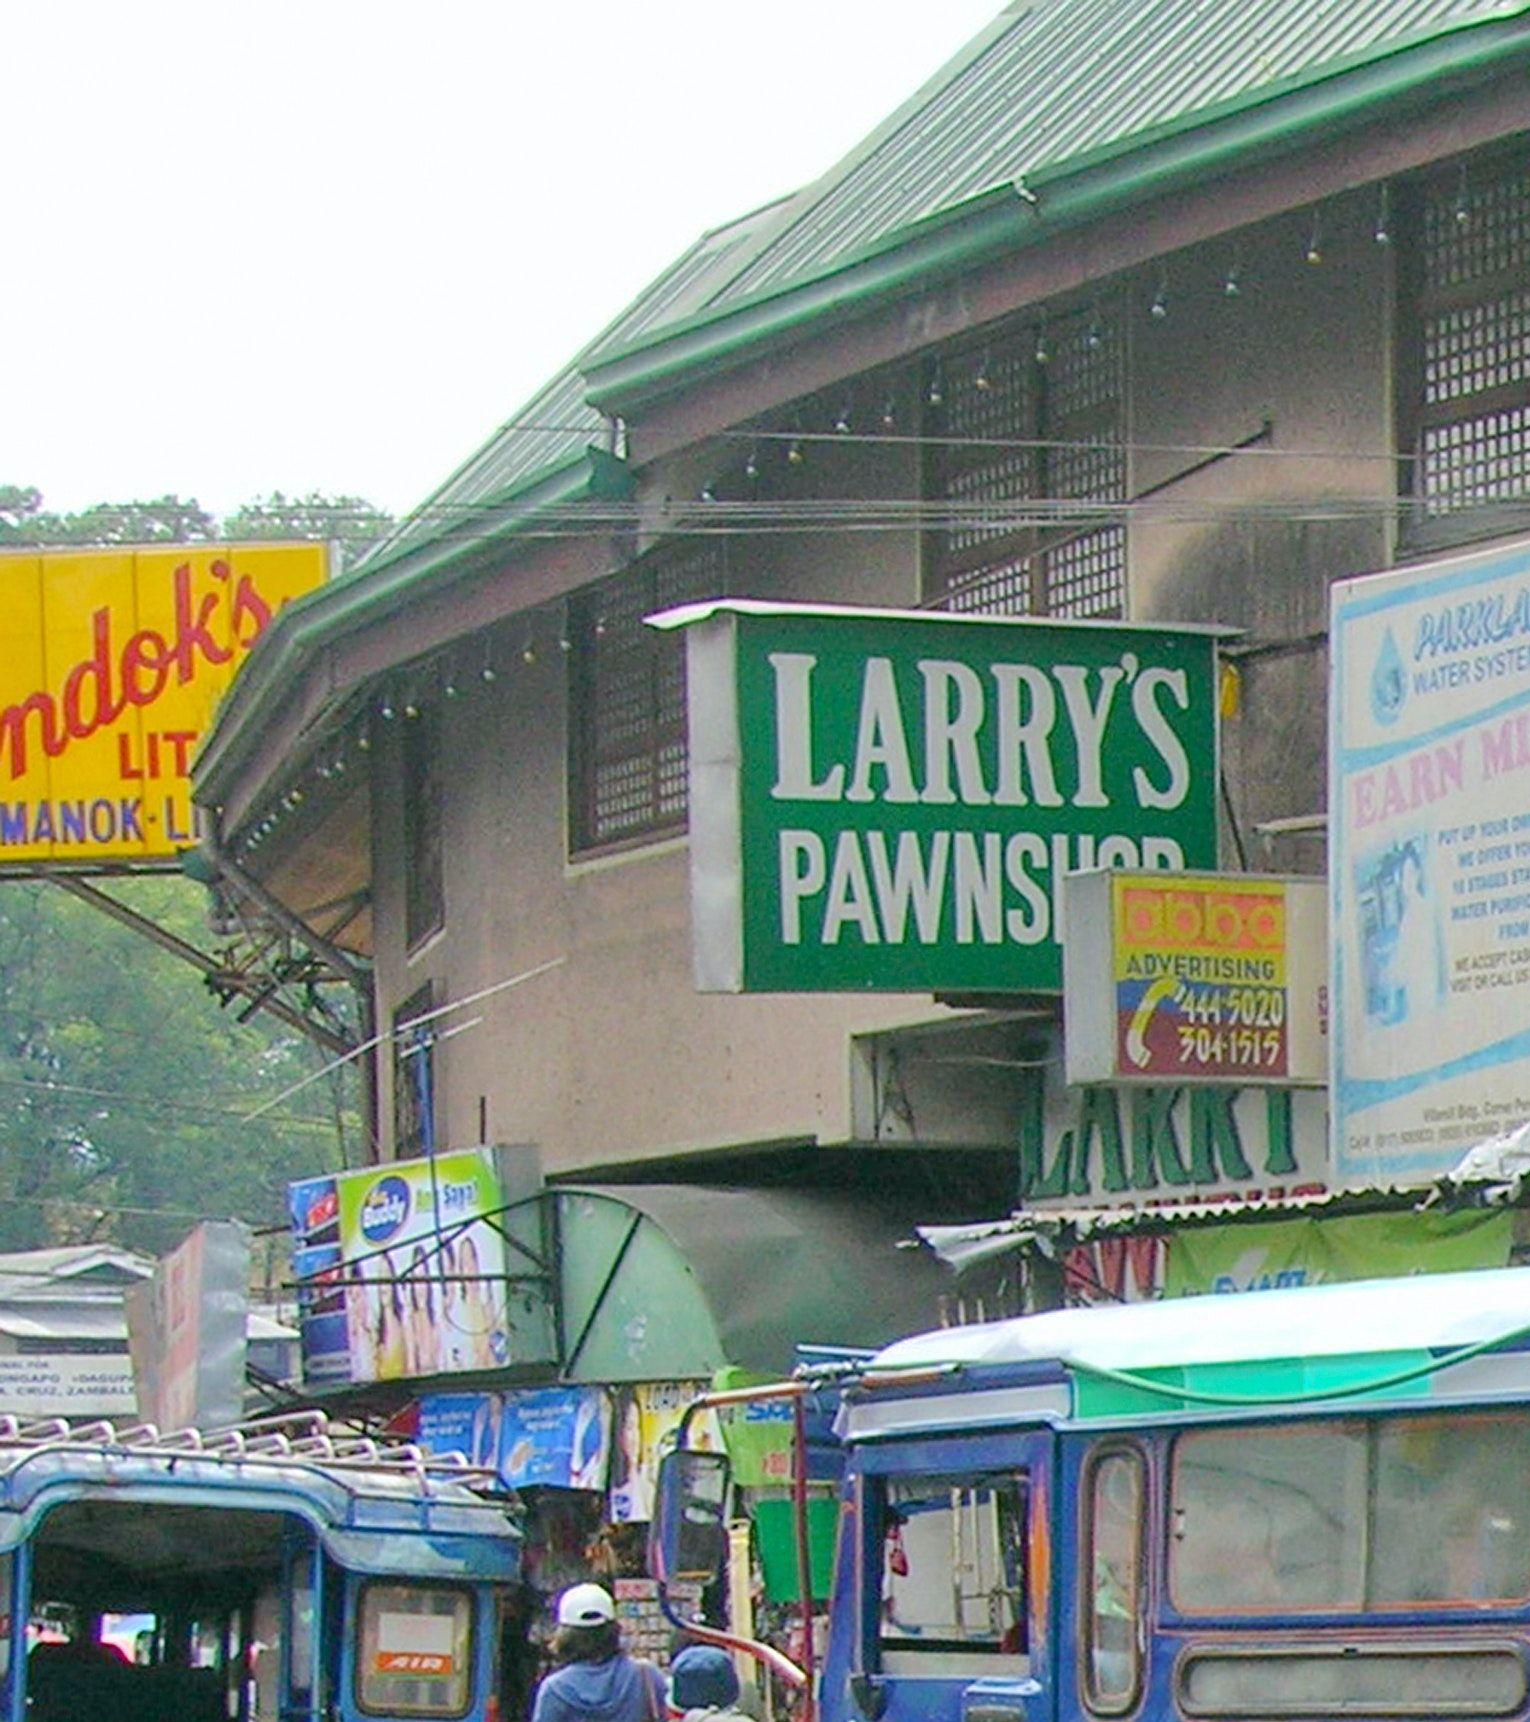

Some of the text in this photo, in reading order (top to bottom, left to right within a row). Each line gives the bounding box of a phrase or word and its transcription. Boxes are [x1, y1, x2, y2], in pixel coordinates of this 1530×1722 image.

[1413, 660, 1470, 695] WATER
[768, 650, 1191, 810] LARRY'S
[1350, 738, 1465, 831] EARN
[1127, 954, 1275, 981] ADVERTISING
